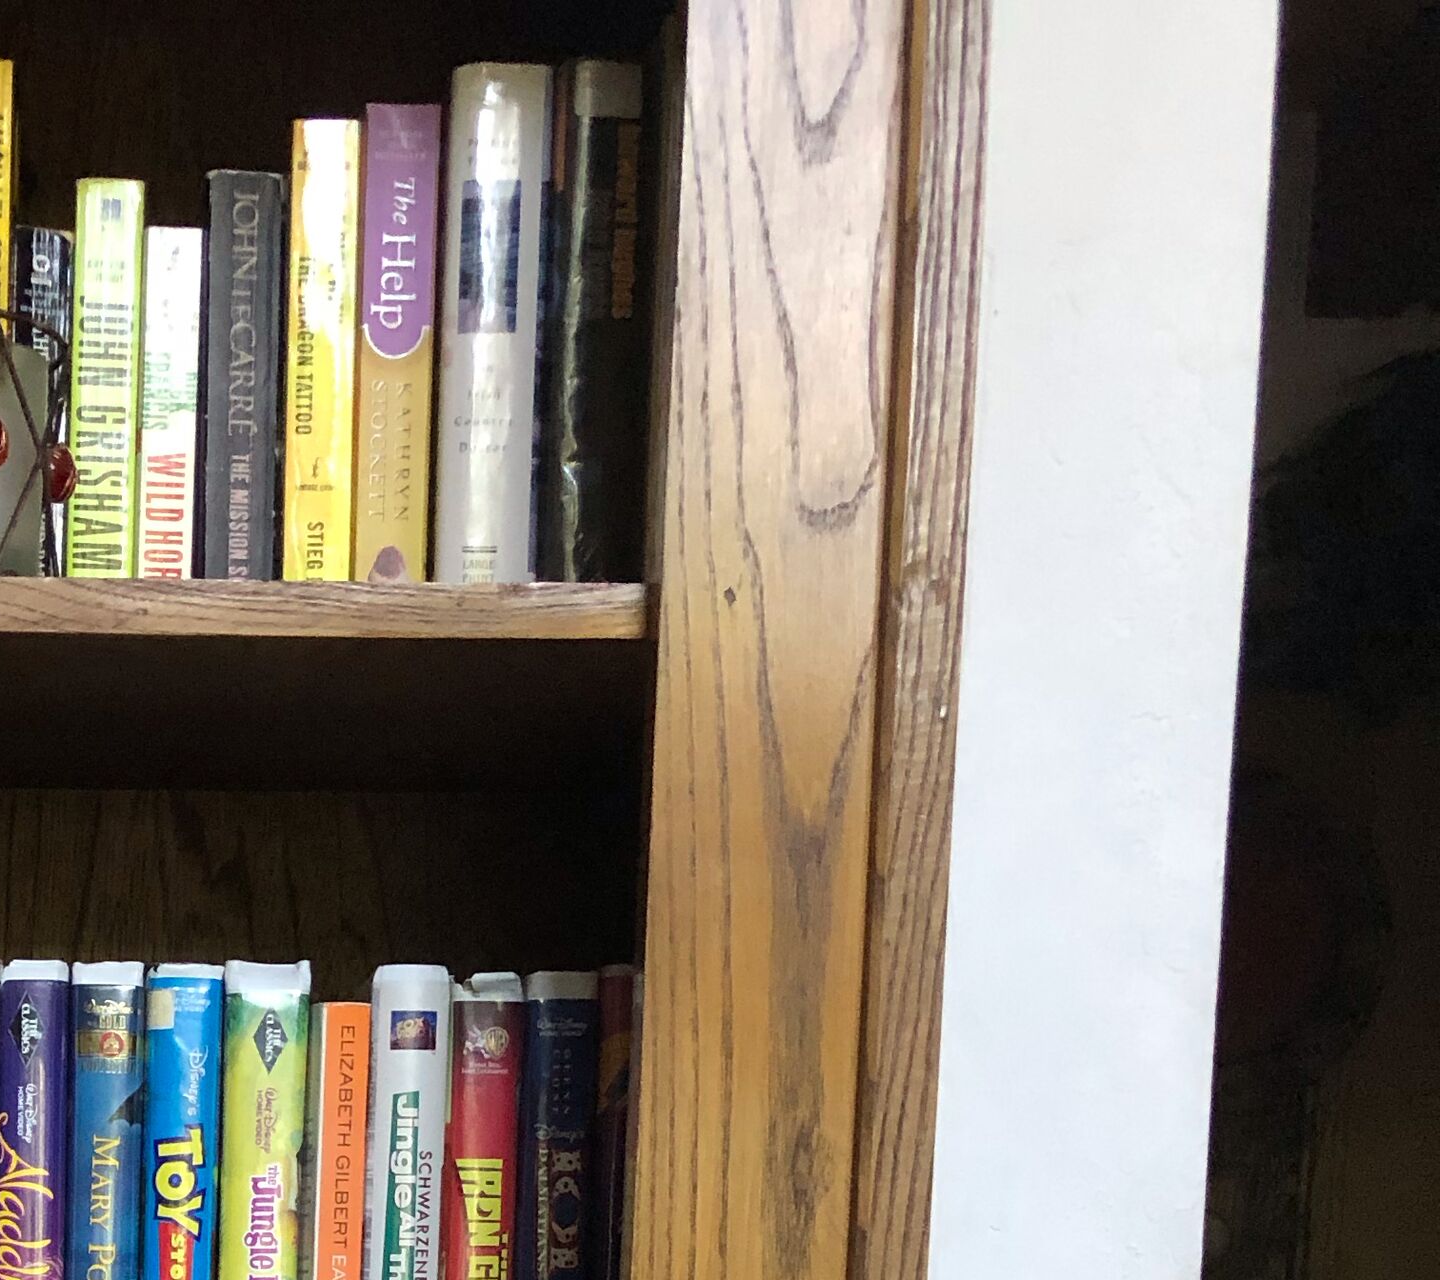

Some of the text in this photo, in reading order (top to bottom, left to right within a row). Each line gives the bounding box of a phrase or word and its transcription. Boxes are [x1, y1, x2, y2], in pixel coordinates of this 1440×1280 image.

[231, 189, 261, 283] JOHN
[368, 176, 418, 330] The Help
[72, 295, 134, 573] JOHN GRISHAM
[295, 371, 315, 435] TATTOO
[369, 379, 391, 523] STOCKETT
[145, 452, 187, 522] WILD
[231, 453, 252, 484] THE
[392, 382, 414, 523] KATHRYN
[228, 487, 251, 561] MISSION
[304, 520, 325, 569] STIEG
[335, 1025, 358, 1148] ELIZABETH
[88, 1134, 122, 1232] MARY
[154, 1125, 205, 1238] TOY
[390, 1094, 419, 1210] Jingle
[243, 1176, 283, 1271] Jungle
[331, 1154, 353, 1251] GILBERT
[397, 1209, 416, 1249] All
[454, 1157, 504, 1247] IRON
